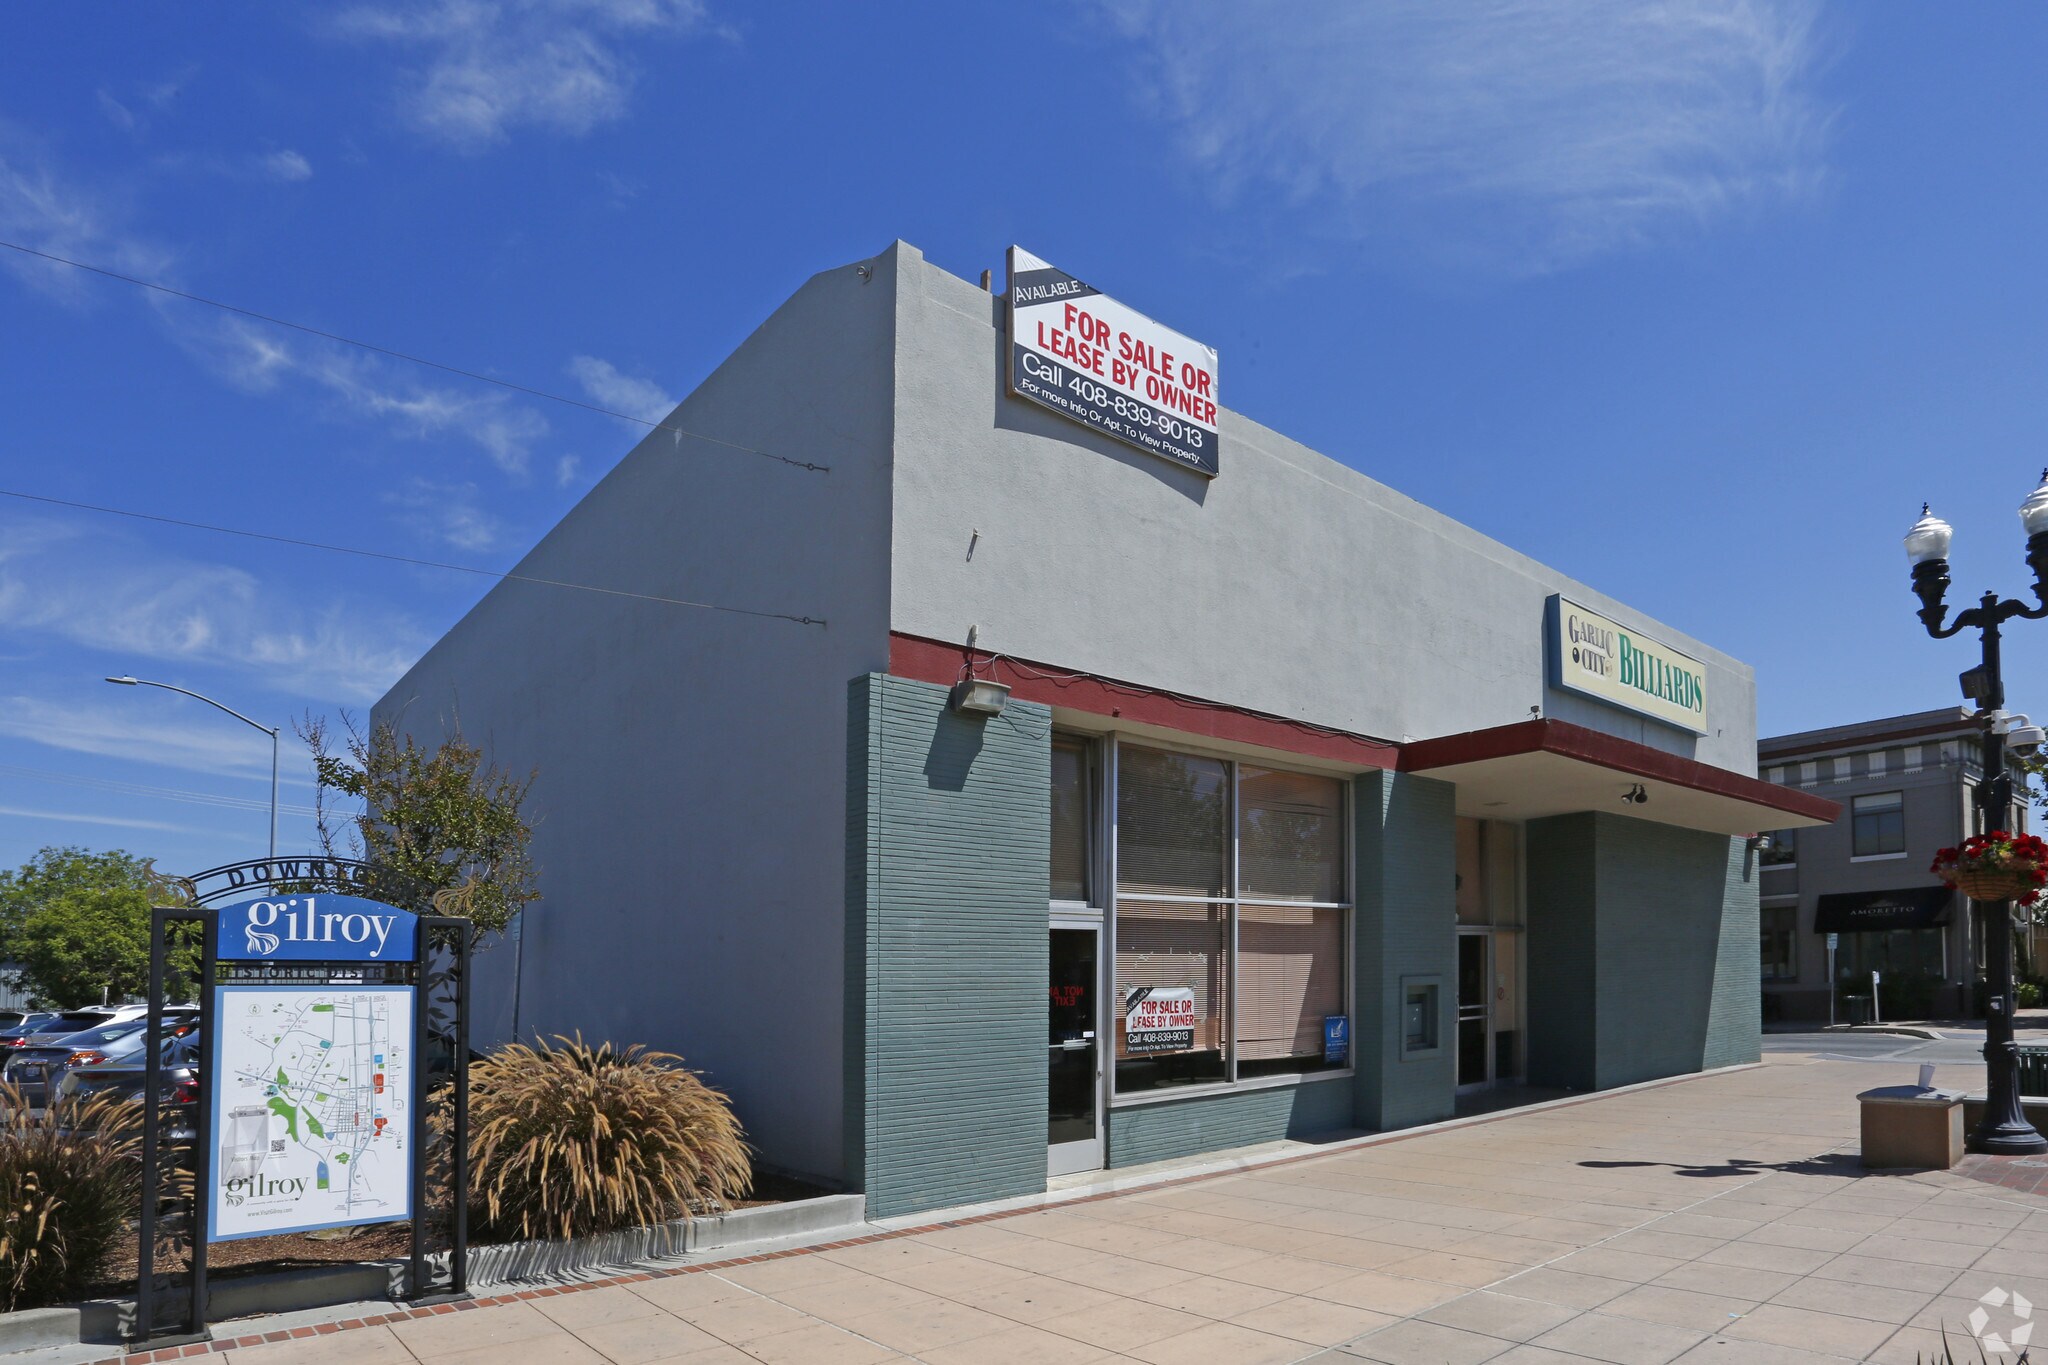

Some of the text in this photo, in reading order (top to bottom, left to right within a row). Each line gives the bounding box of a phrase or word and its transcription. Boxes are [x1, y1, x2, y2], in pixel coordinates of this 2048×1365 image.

[1016, 280, 1081, 302] AVAILABLE
[1065, 302, 1211, 398] FOR SALE OR
[1037, 320, 1217, 427] LEASE BY OWNER
[1022, 352, 1203, 448] Call 408-839-9013
[1022, 378, 1200, 464] For more Info Or Apt. To View Property
[1568, 614, 1615, 659] GARLIC
[1581, 648, 1607, 676] CITY
[1618, 632, 1703, 714] BILLIARDS
[244, 897, 398, 958] gilroy
[1141, 1000, 1192, 1014] FOR SALE OR
[1157, 1015, 1167, 1028] BY
[1169, 1014, 1194, 1027] OWNER
[1128, 1031, 1189, 1044] Call 408-839-9013
[225, 1172, 310, 1207] gilroy
